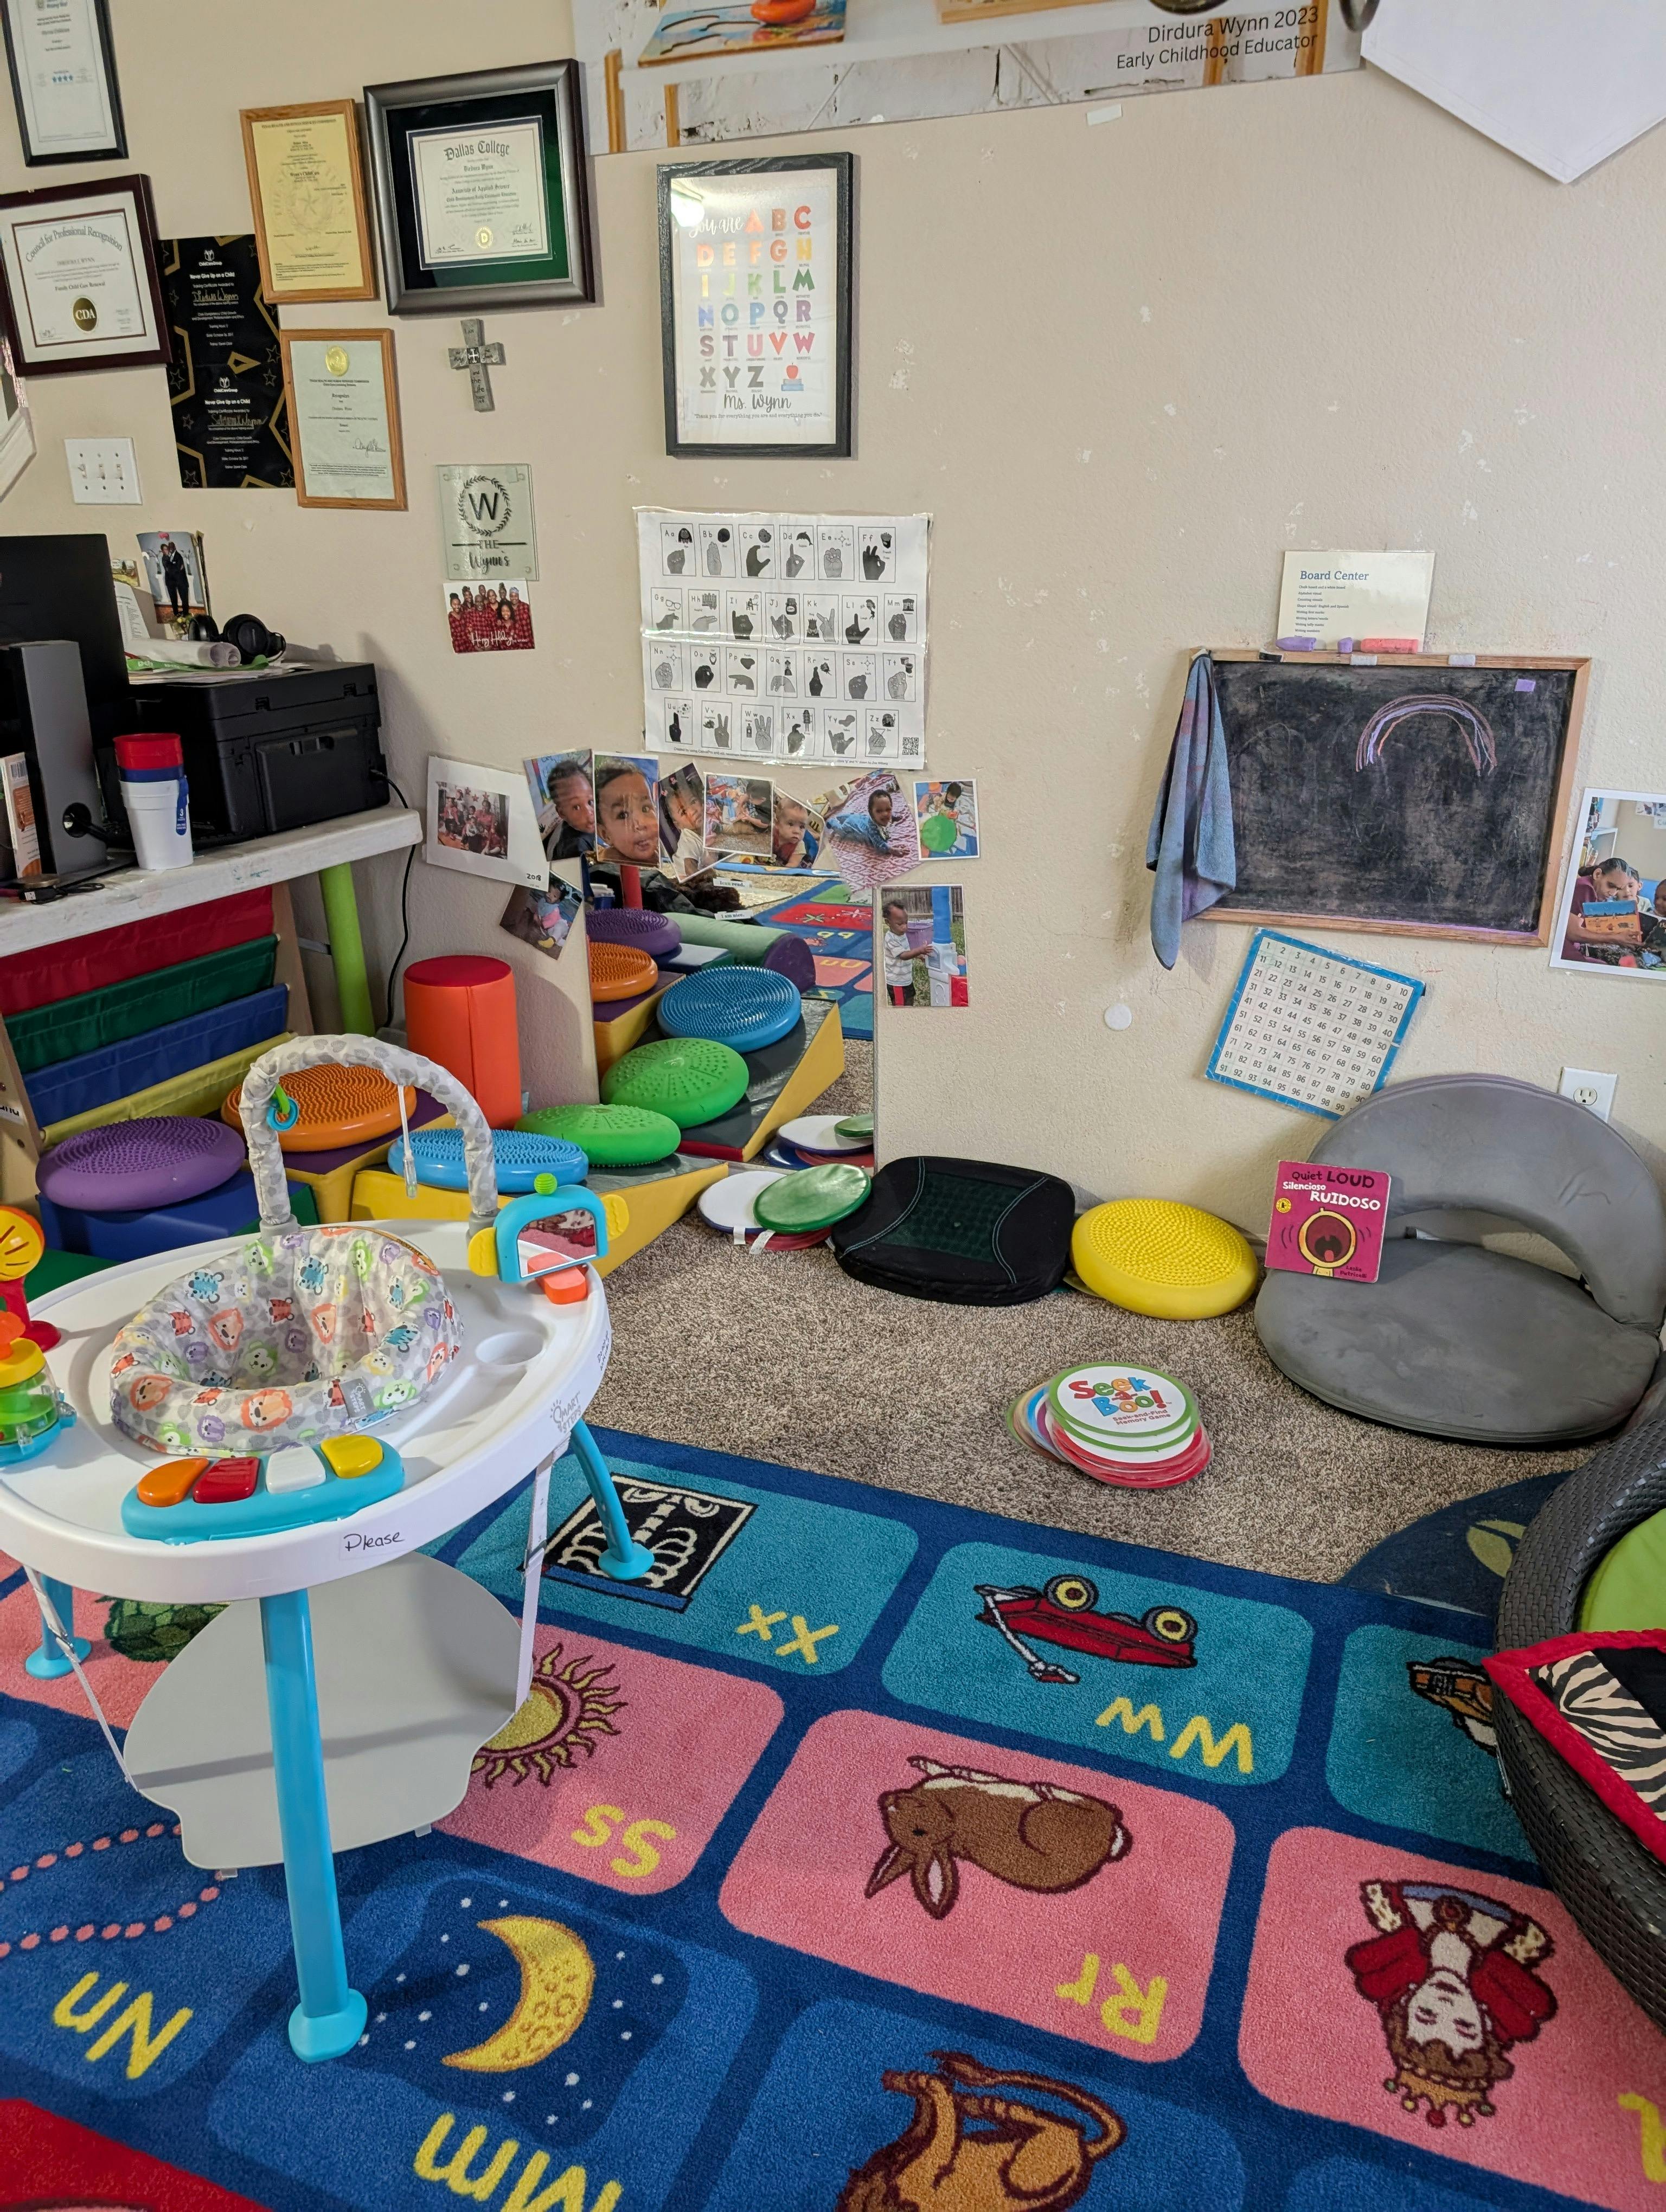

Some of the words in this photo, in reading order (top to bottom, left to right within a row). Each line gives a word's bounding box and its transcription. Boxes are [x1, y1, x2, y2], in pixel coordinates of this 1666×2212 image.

[1149, 20, 1214, 43] Dirdura
[1219, 15, 1268, 37] Wynn
[1274, 7, 1318, 26] 2023
[1117, 52, 1155, 70] Early
[1159, 44, 1239, 64] Childhood
[1245, 34, 1317, 55] Educator
[444, 145, 474, 160] Dallas
[478, 140, 510, 157] College
[719, 216, 744, 233] are
[745, 209, 764, 234] A
[772, 209, 786, 231] B
[794, 206, 811, 229] C
[25, 238, 46, 262] Council
[45, 234, 54, 244] for
[54, 226, 86, 240] Professional
[88, 227, 123, 251] Recognition
[697, 244, 714, 267] D
[723, 242, 735, 266] E
[750, 241, 761, 263] F
[771, 240, 787, 262] G
[797, 238, 811, 261] H
[702, 274, 708, 297] I
[723, 273, 734, 295] J
[748, 273, 762, 295] K
[773, 270, 786, 293] L
[793, 268, 815, 291] M
[75, 309, 96, 320] CDA
[699, 306, 714, 327] N
[721, 304, 739, 325] O
[750, 303, 765, 325] P
[773, 300, 787, 324] Q
[797, 300, 811, 321] R
[700, 335, 714, 357] S
[722, 335, 738, 356] T
[747, 334, 763, 356] U
[769, 332, 787, 355] V
[793, 332, 815, 353] W
[700, 366, 716, 388] X
[722, 366, 741, 388] Y
[748, 366, 764, 388] Z
[724, 394, 746, 409] Ms.
[752, 394, 791, 413] Wynn
[469, 493, 498, 520] W
[478, 540, 499, 549] THE
[1300, 571, 1330, 581] Board
[1334, 571, 1369, 581] Center
[1254, 968, 1262, 977] 21
[1267, 974, 1277, 982] 22
[1283, 979, 1292, 987] 23
[1297, 983, 1306, 992] 24
[1274, 960, 1281, 968] 12
[1304, 970, 1311, 978] 14
[1334, 980, 1341, 988] 16
[1364, 991, 1372, 999] 18
[1379, 996, 1387, 1004] 19
[1393, 1001, 1402, 1010] 20
[1400, 988, 1408, 996] 10
[1283, 1182, 1327, 1191] Silencioso
[1292, 1171, 1322, 1181] Quiet
[1327, 1171, 1374, 1188] LOUD
[1310, 1191, 1381, 1210] RUIDOSO
[1068, 1376, 1152, 1399] Seek
[1091, 1390, 1167, 1417] Boo!
[1113, 1410, 1168, 1421] Seek-and-Find
[563, 1405, 581, 1433] STEPS
[343, 1529, 407, 1553] Please
[1095, 1695, 1254, 1775] Ww
[571, 1804, 676, 1877] Ss
[1055, 1952, 1168, 2045] Rr
[53, 1970, 194, 2080] Nn
